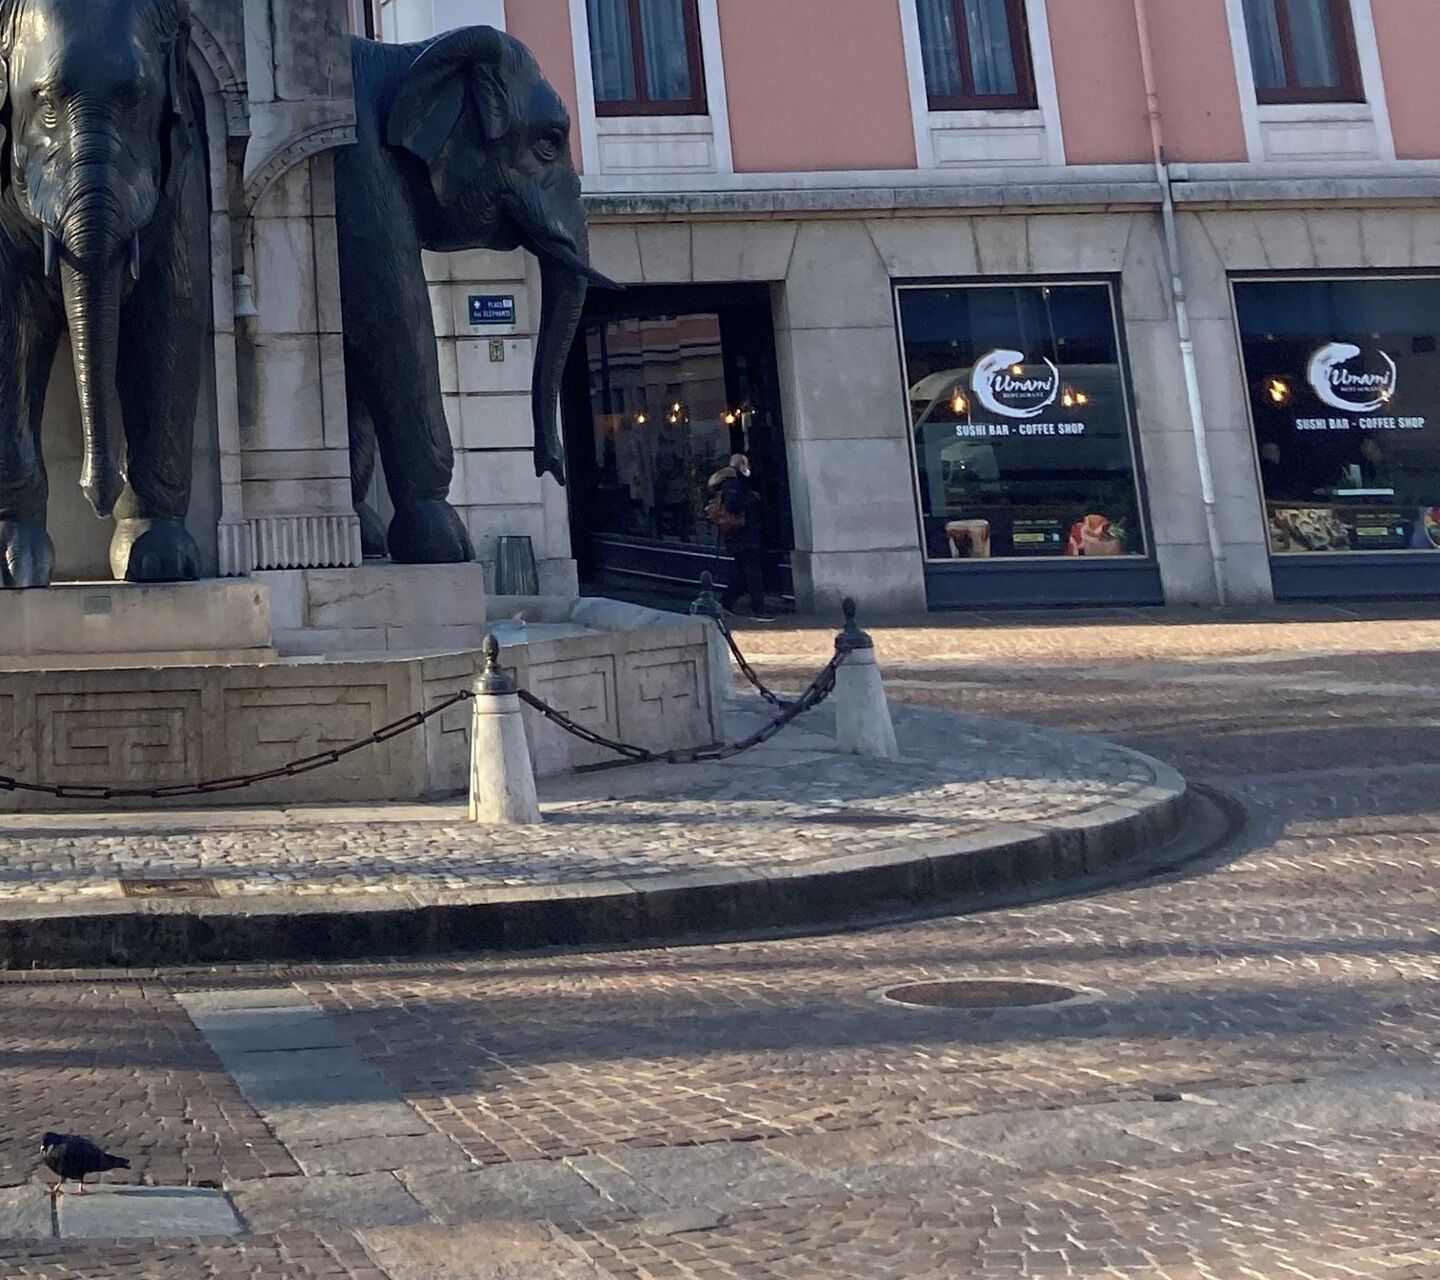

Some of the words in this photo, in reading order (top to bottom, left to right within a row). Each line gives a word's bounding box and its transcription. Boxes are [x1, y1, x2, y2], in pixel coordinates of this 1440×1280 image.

[994, 374, 1052, 392] Umami
[1331, 368, 1391, 386] Umami
[955, 424, 987, 437] SUSHI
[989, 424, 1009, 436] BAR
[1018, 423, 1056, 436] COFFEE
[1058, 422, 1085, 435] SHOP
[1295, 418, 1327, 430] SUSHI
[1329, 417, 1350, 429] BAR
[1358, 417, 1396, 429] COFFEE
[1398, 416, 1426, 429] SHOP
